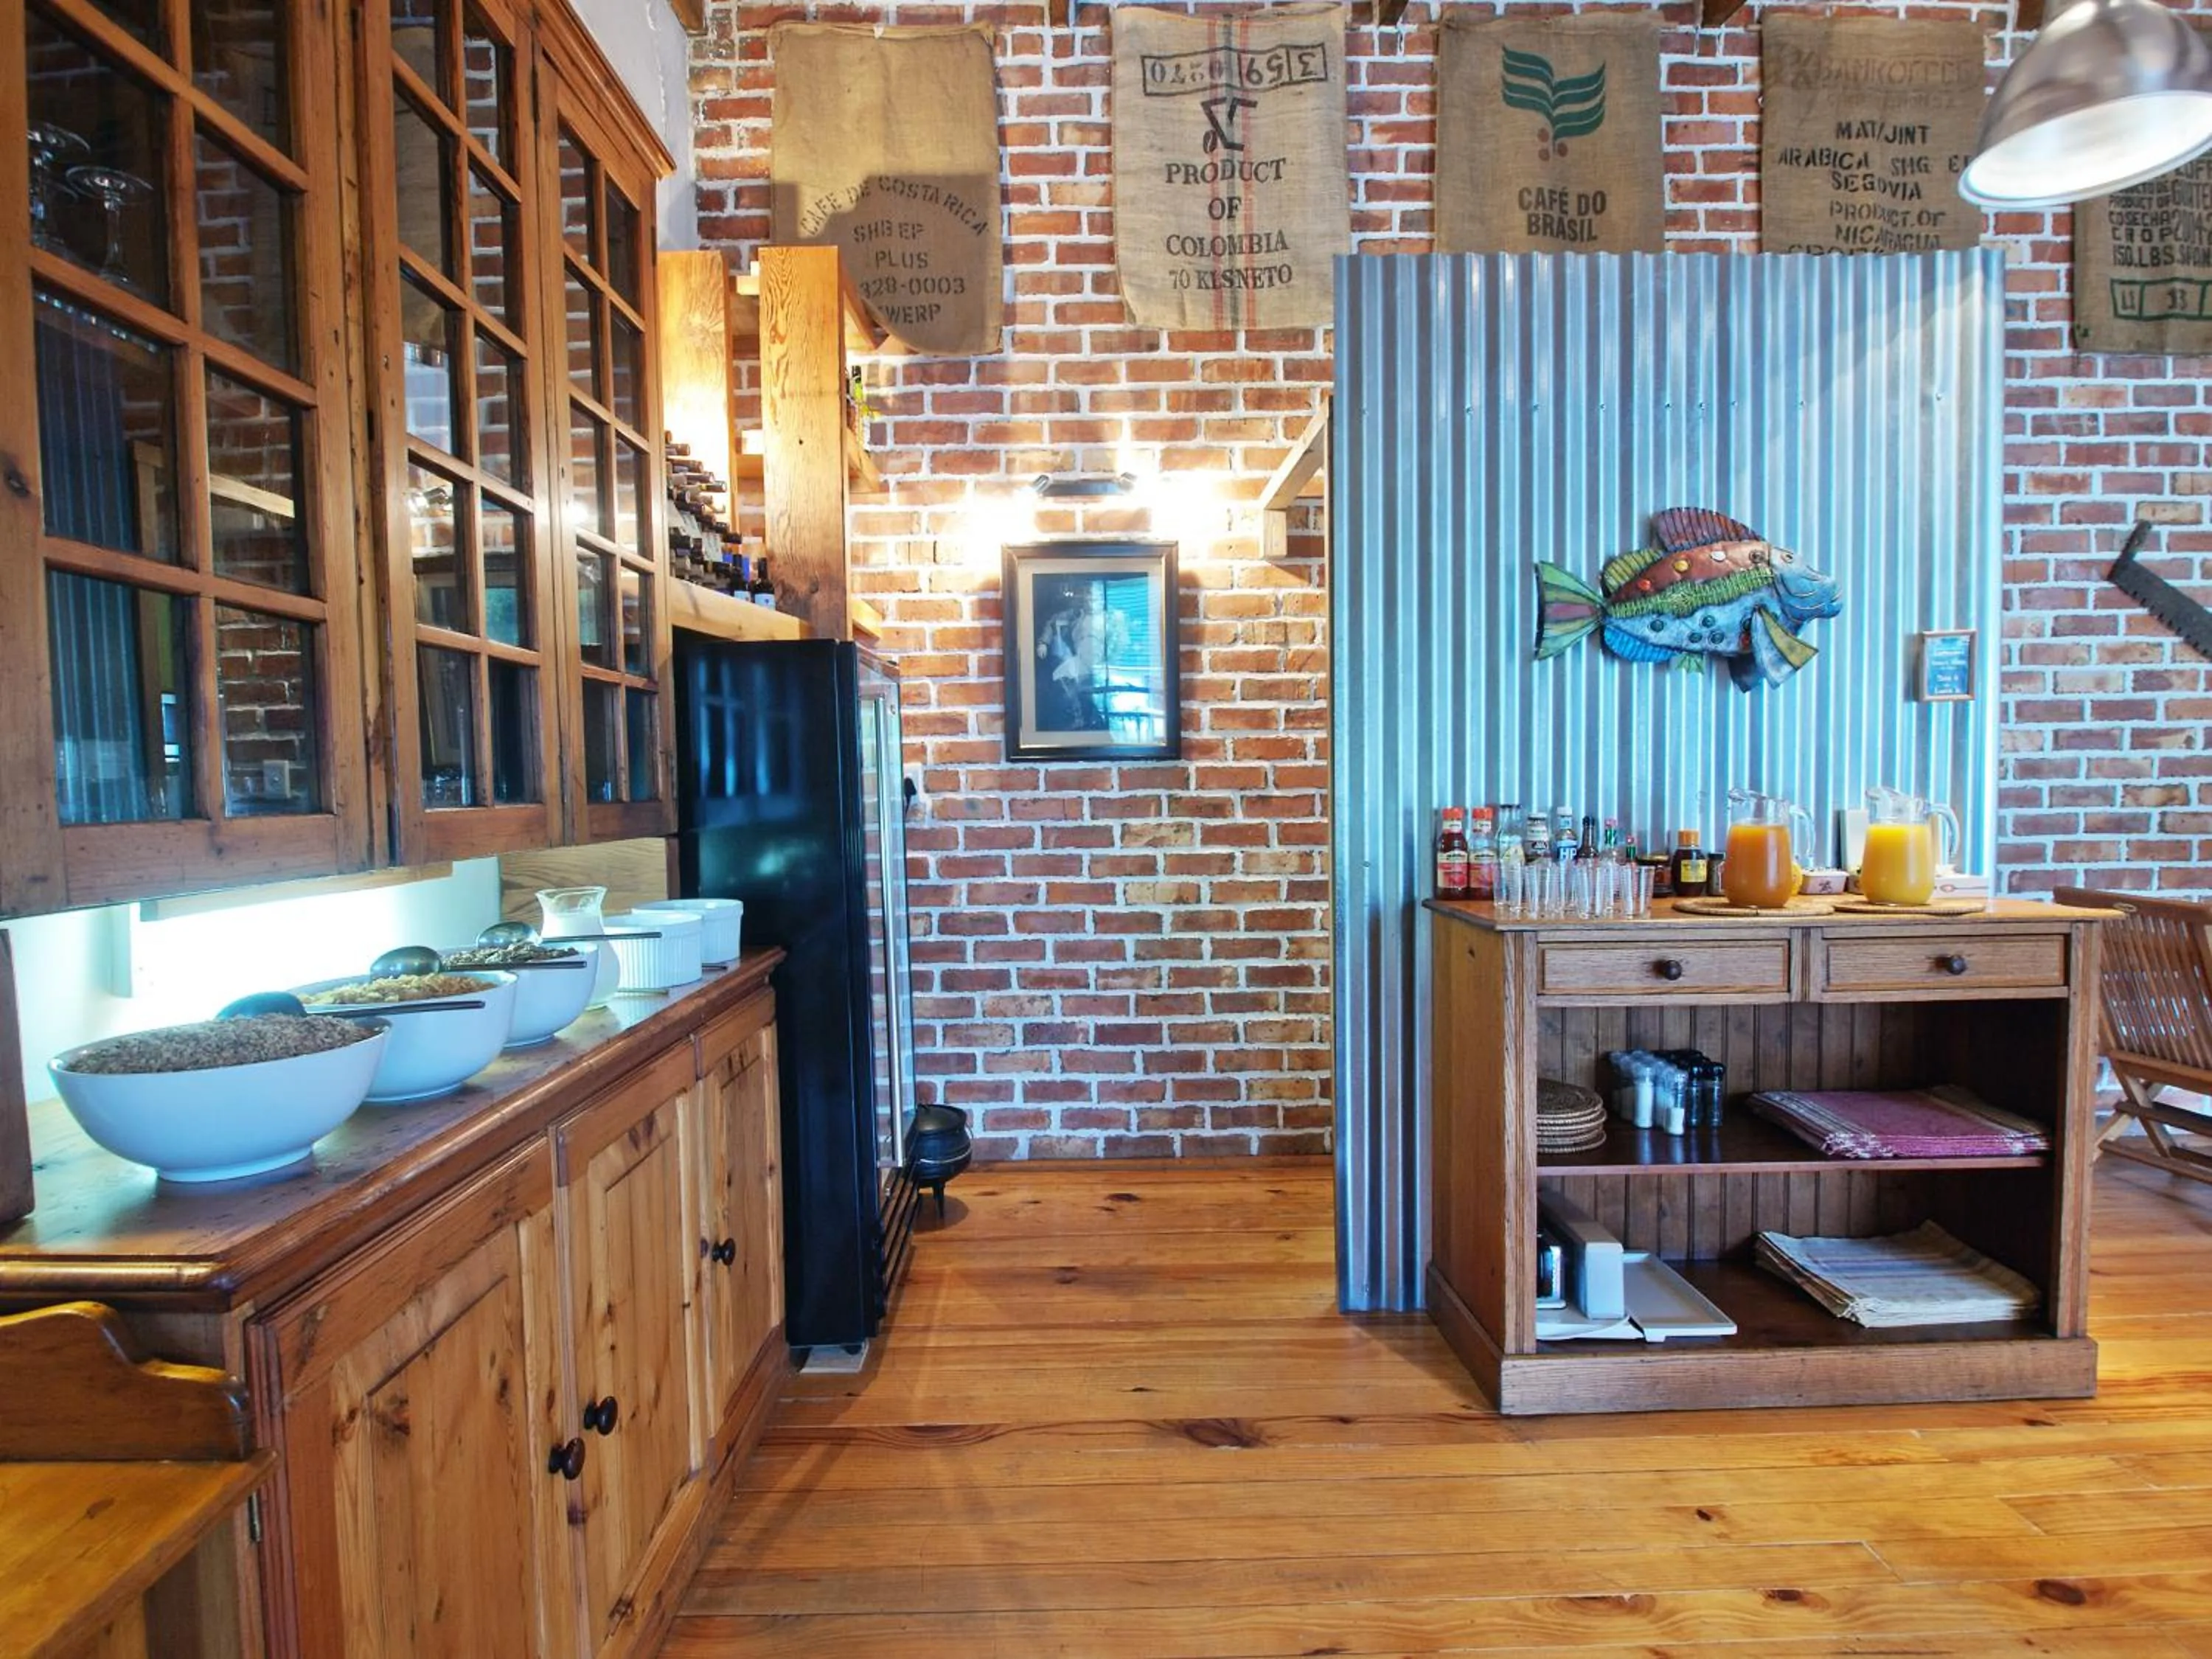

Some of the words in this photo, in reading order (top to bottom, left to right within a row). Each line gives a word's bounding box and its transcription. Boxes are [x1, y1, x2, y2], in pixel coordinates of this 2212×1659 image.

[1165, 158, 1287, 185] PRODUCT
[1778, 147, 1870, 170] ARABICA
[1831, 170, 1922, 201] SEGOVIA
[800, 192, 842, 237] CAFE
[878, 175, 940, 205] COSTA
[943, 192, 989, 237] RICA
[1208, 197, 1242, 220] OF
[1517, 187, 1569, 215] CAFÉ
[1576, 191, 1607, 215] DO
[1526, 213, 1598, 243] BRASIL
[1166, 229, 1290, 257] COLOMBIA
[875, 250, 928, 270] PLUS
[1169, 268, 1191, 290] 70
[1559, 848, 1577, 860] HP
